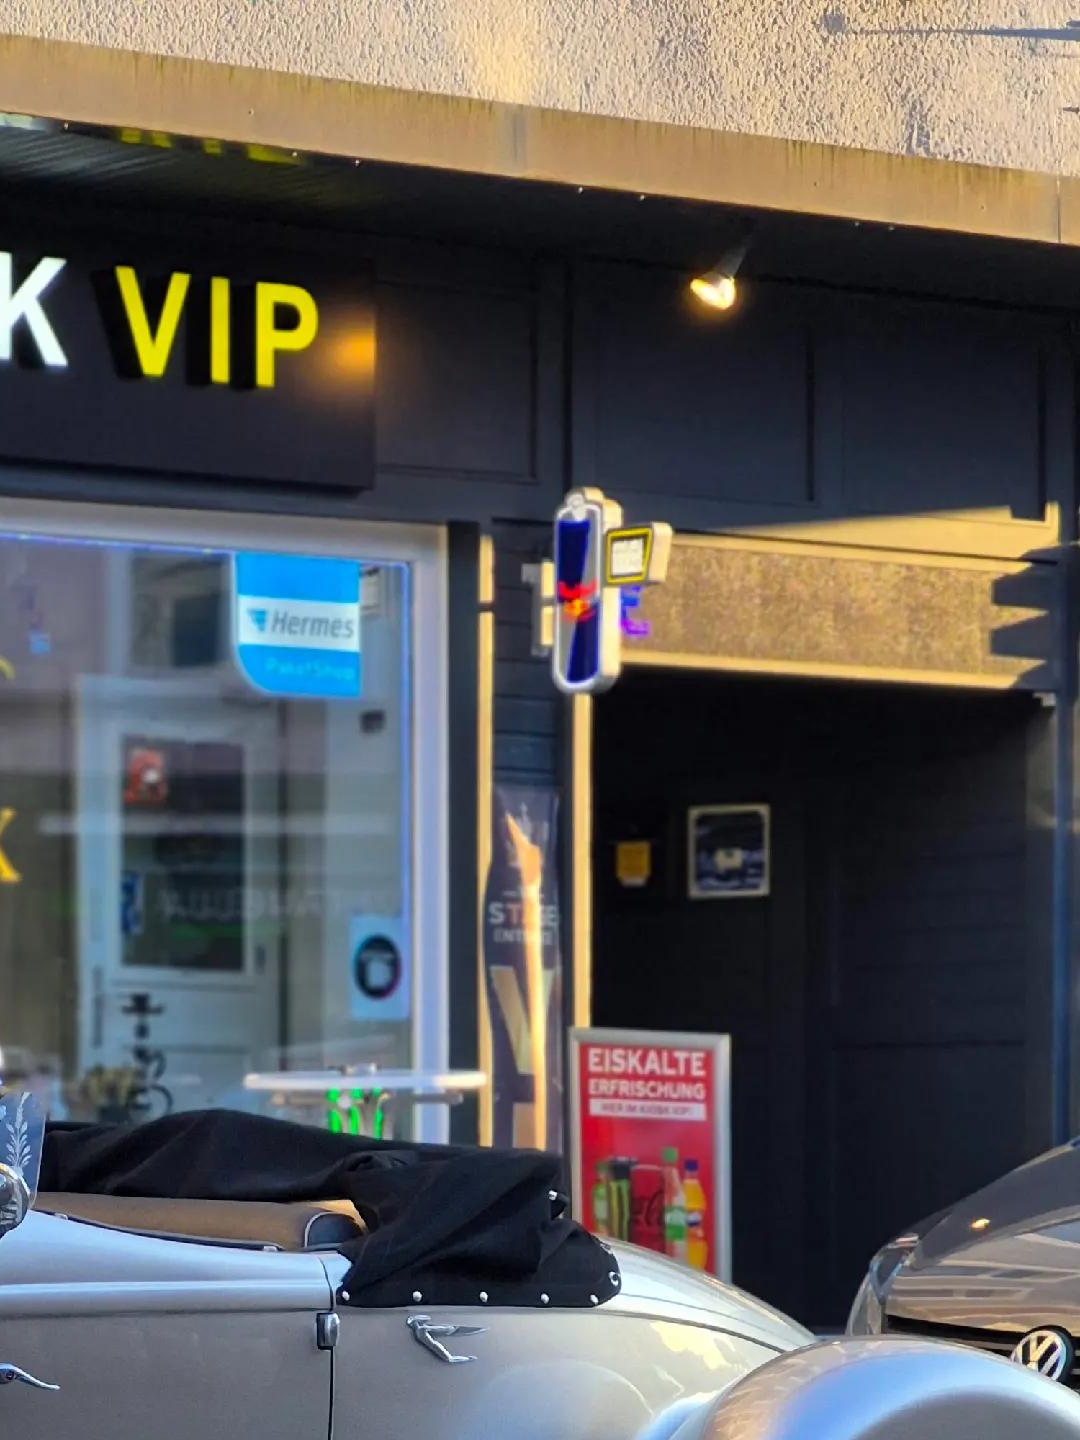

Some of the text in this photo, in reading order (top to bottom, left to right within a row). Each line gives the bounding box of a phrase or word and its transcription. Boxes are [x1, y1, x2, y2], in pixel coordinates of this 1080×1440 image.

[115, 265, 319, 387] VIP
[271, 611, 355, 639] Hermes
[587, 1047, 707, 1077] EISKALTE
[588, 1078, 706, 1100] ERFRISCHUNG
